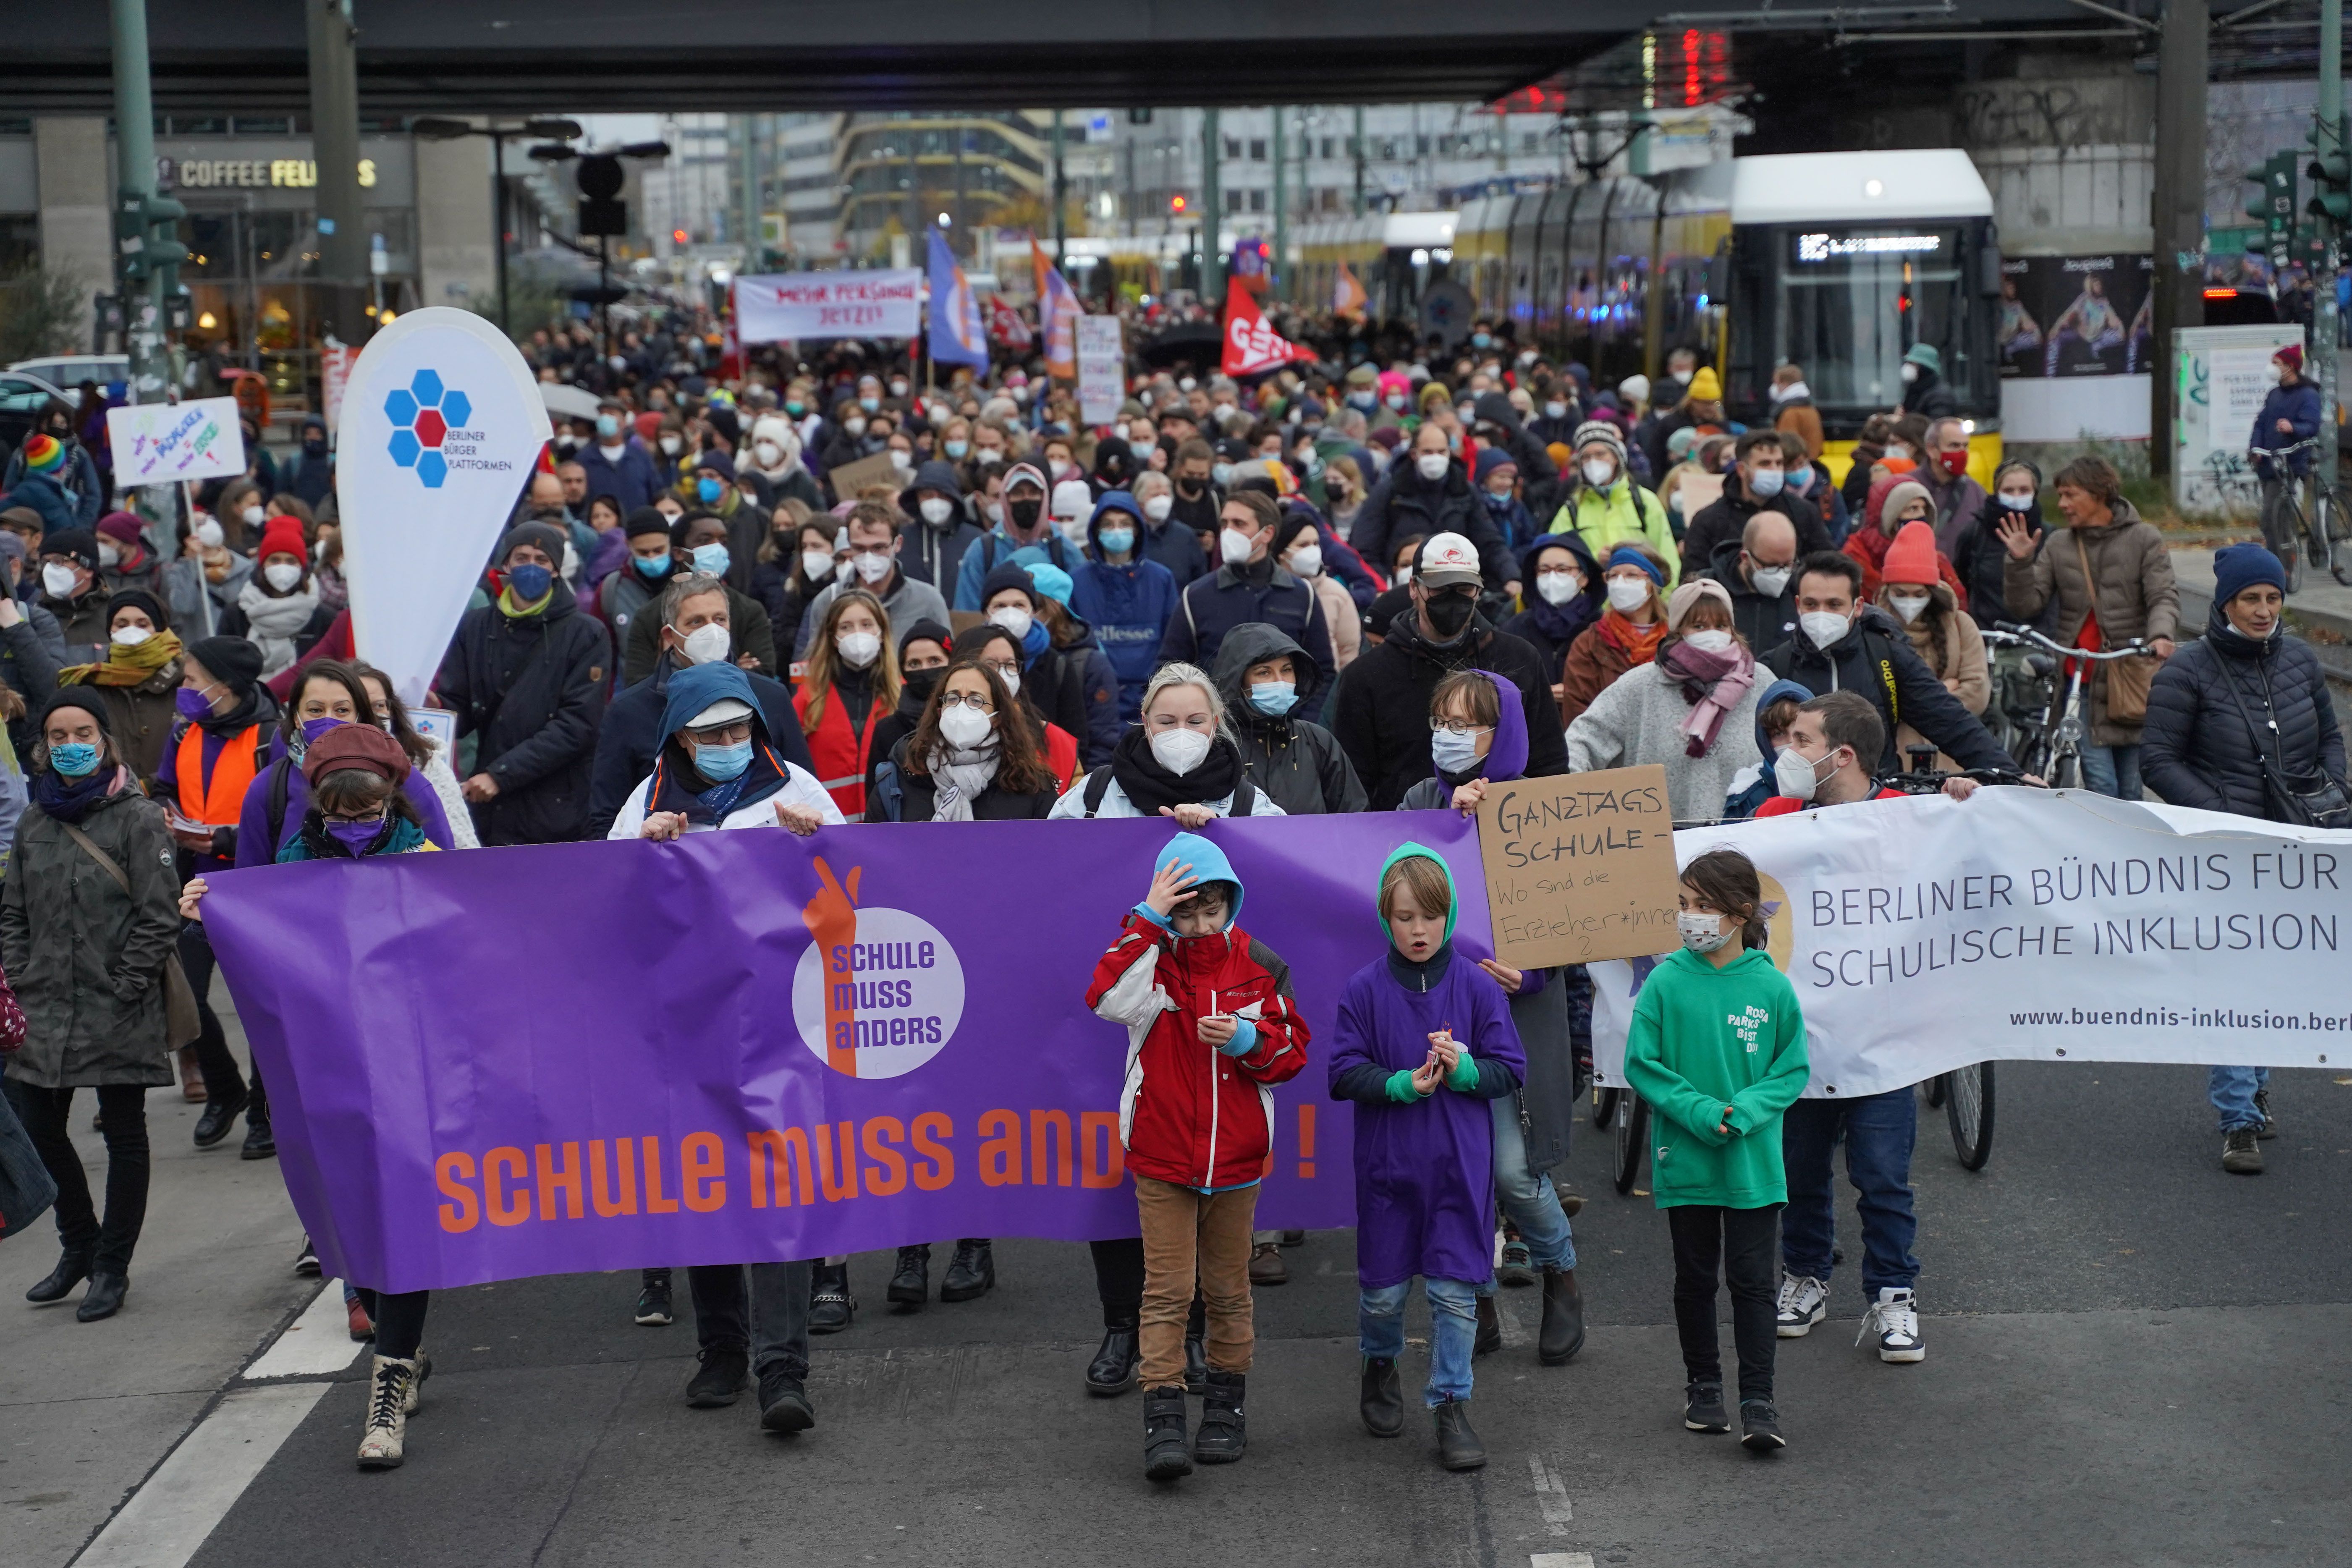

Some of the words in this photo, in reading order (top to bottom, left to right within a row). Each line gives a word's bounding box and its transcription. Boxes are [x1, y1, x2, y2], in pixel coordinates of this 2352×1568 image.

[181, 159, 267, 187] COFFEE
[776, 285, 828, 304] MEHR
[447, 431, 486, 441] BERLINER
[444, 444, 477, 455] BÜRGER
[448, 459, 512, 471] PLATTFORMEN
[1498, 787, 1663, 840] GANZTAGS
[1505, 826, 1644, 868] SCHULE
[1496, 877, 1528, 906] Wo
[1583, 870, 1610, 887] die
[1812, 875, 2013, 927] BERLINER
[2031, 853, 2231, 906] BÜNDNIS
[2253, 844, 2340, 890] FÜR
[1578, 936, 1592, 959] ?
[1812, 926, 2074, 988] SCHULISCHE
[2093, 913, 2337, 955] INKLUSION
[1728, 1014, 1760, 1029] PARKS
[1746, 1005, 1768, 1024] ROSA
[1747, 1042, 1758, 1055] DU!
